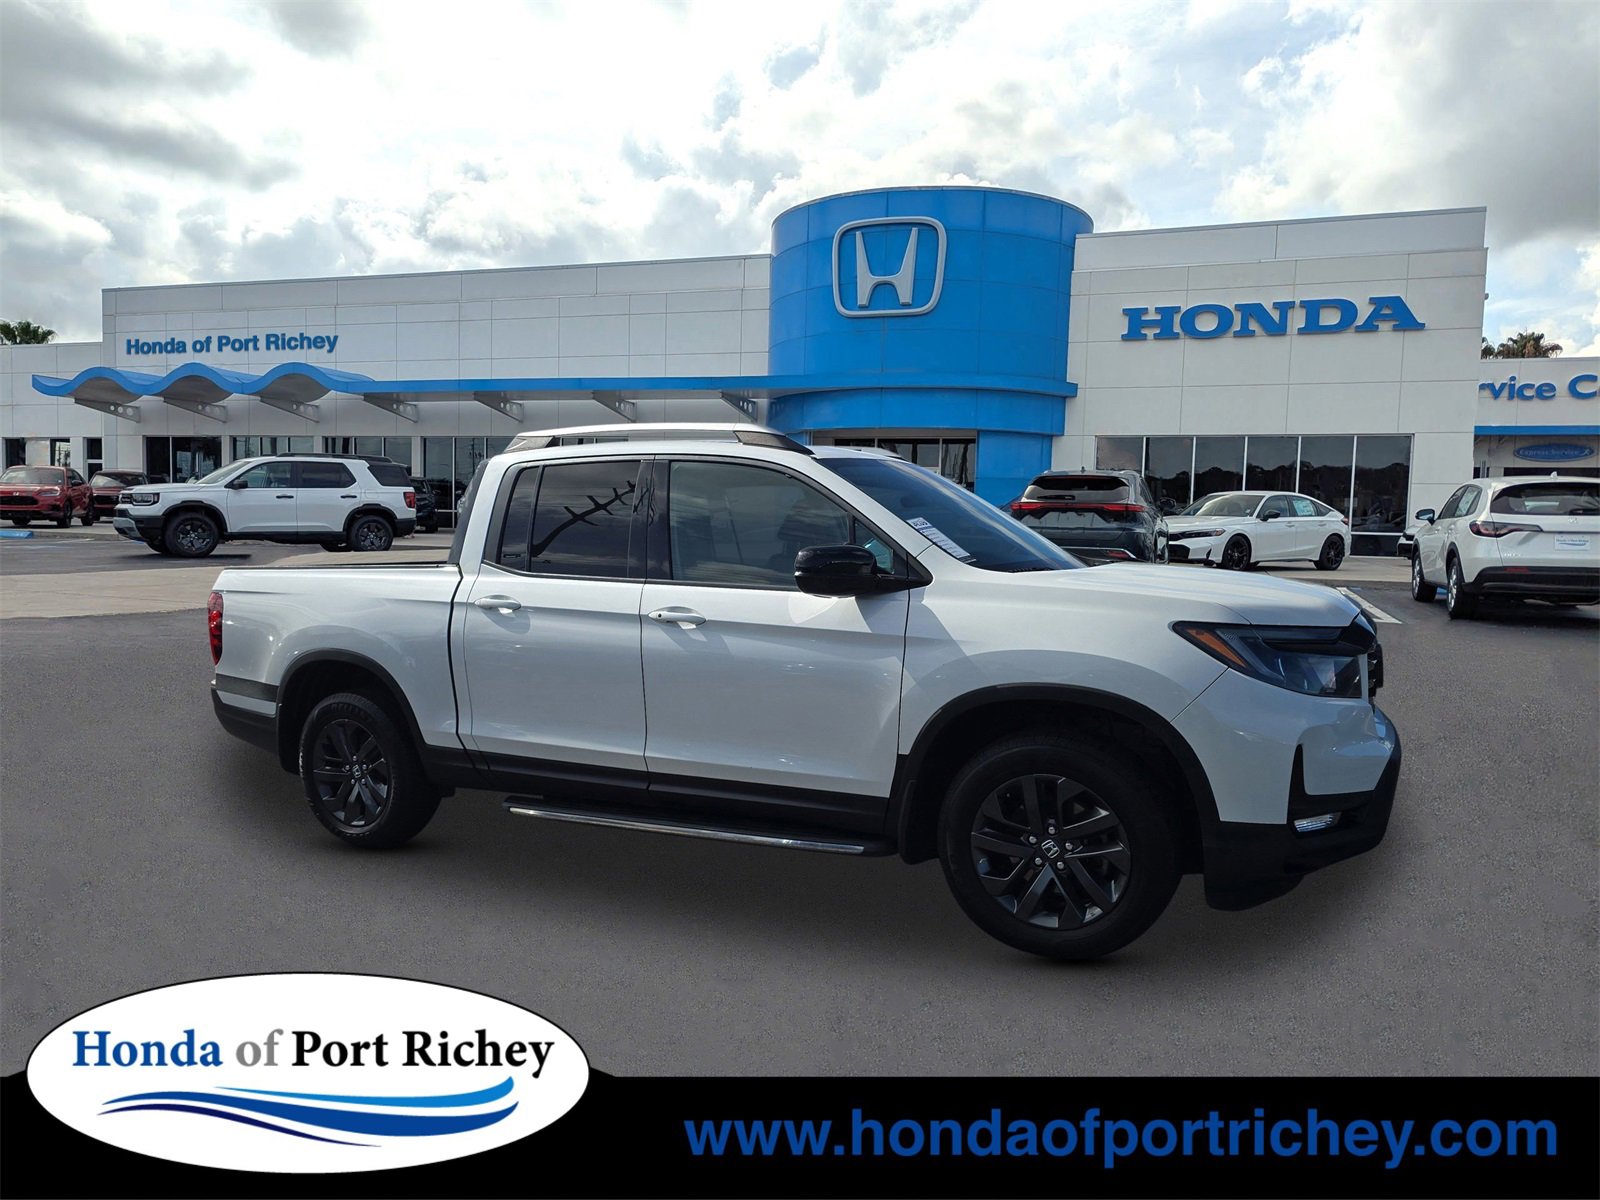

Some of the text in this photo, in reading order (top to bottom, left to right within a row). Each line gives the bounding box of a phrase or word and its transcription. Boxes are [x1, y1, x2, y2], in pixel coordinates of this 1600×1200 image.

[1120, 295, 1426, 341] HONDA
[126, 332, 339, 355] Honda of Port Richey
